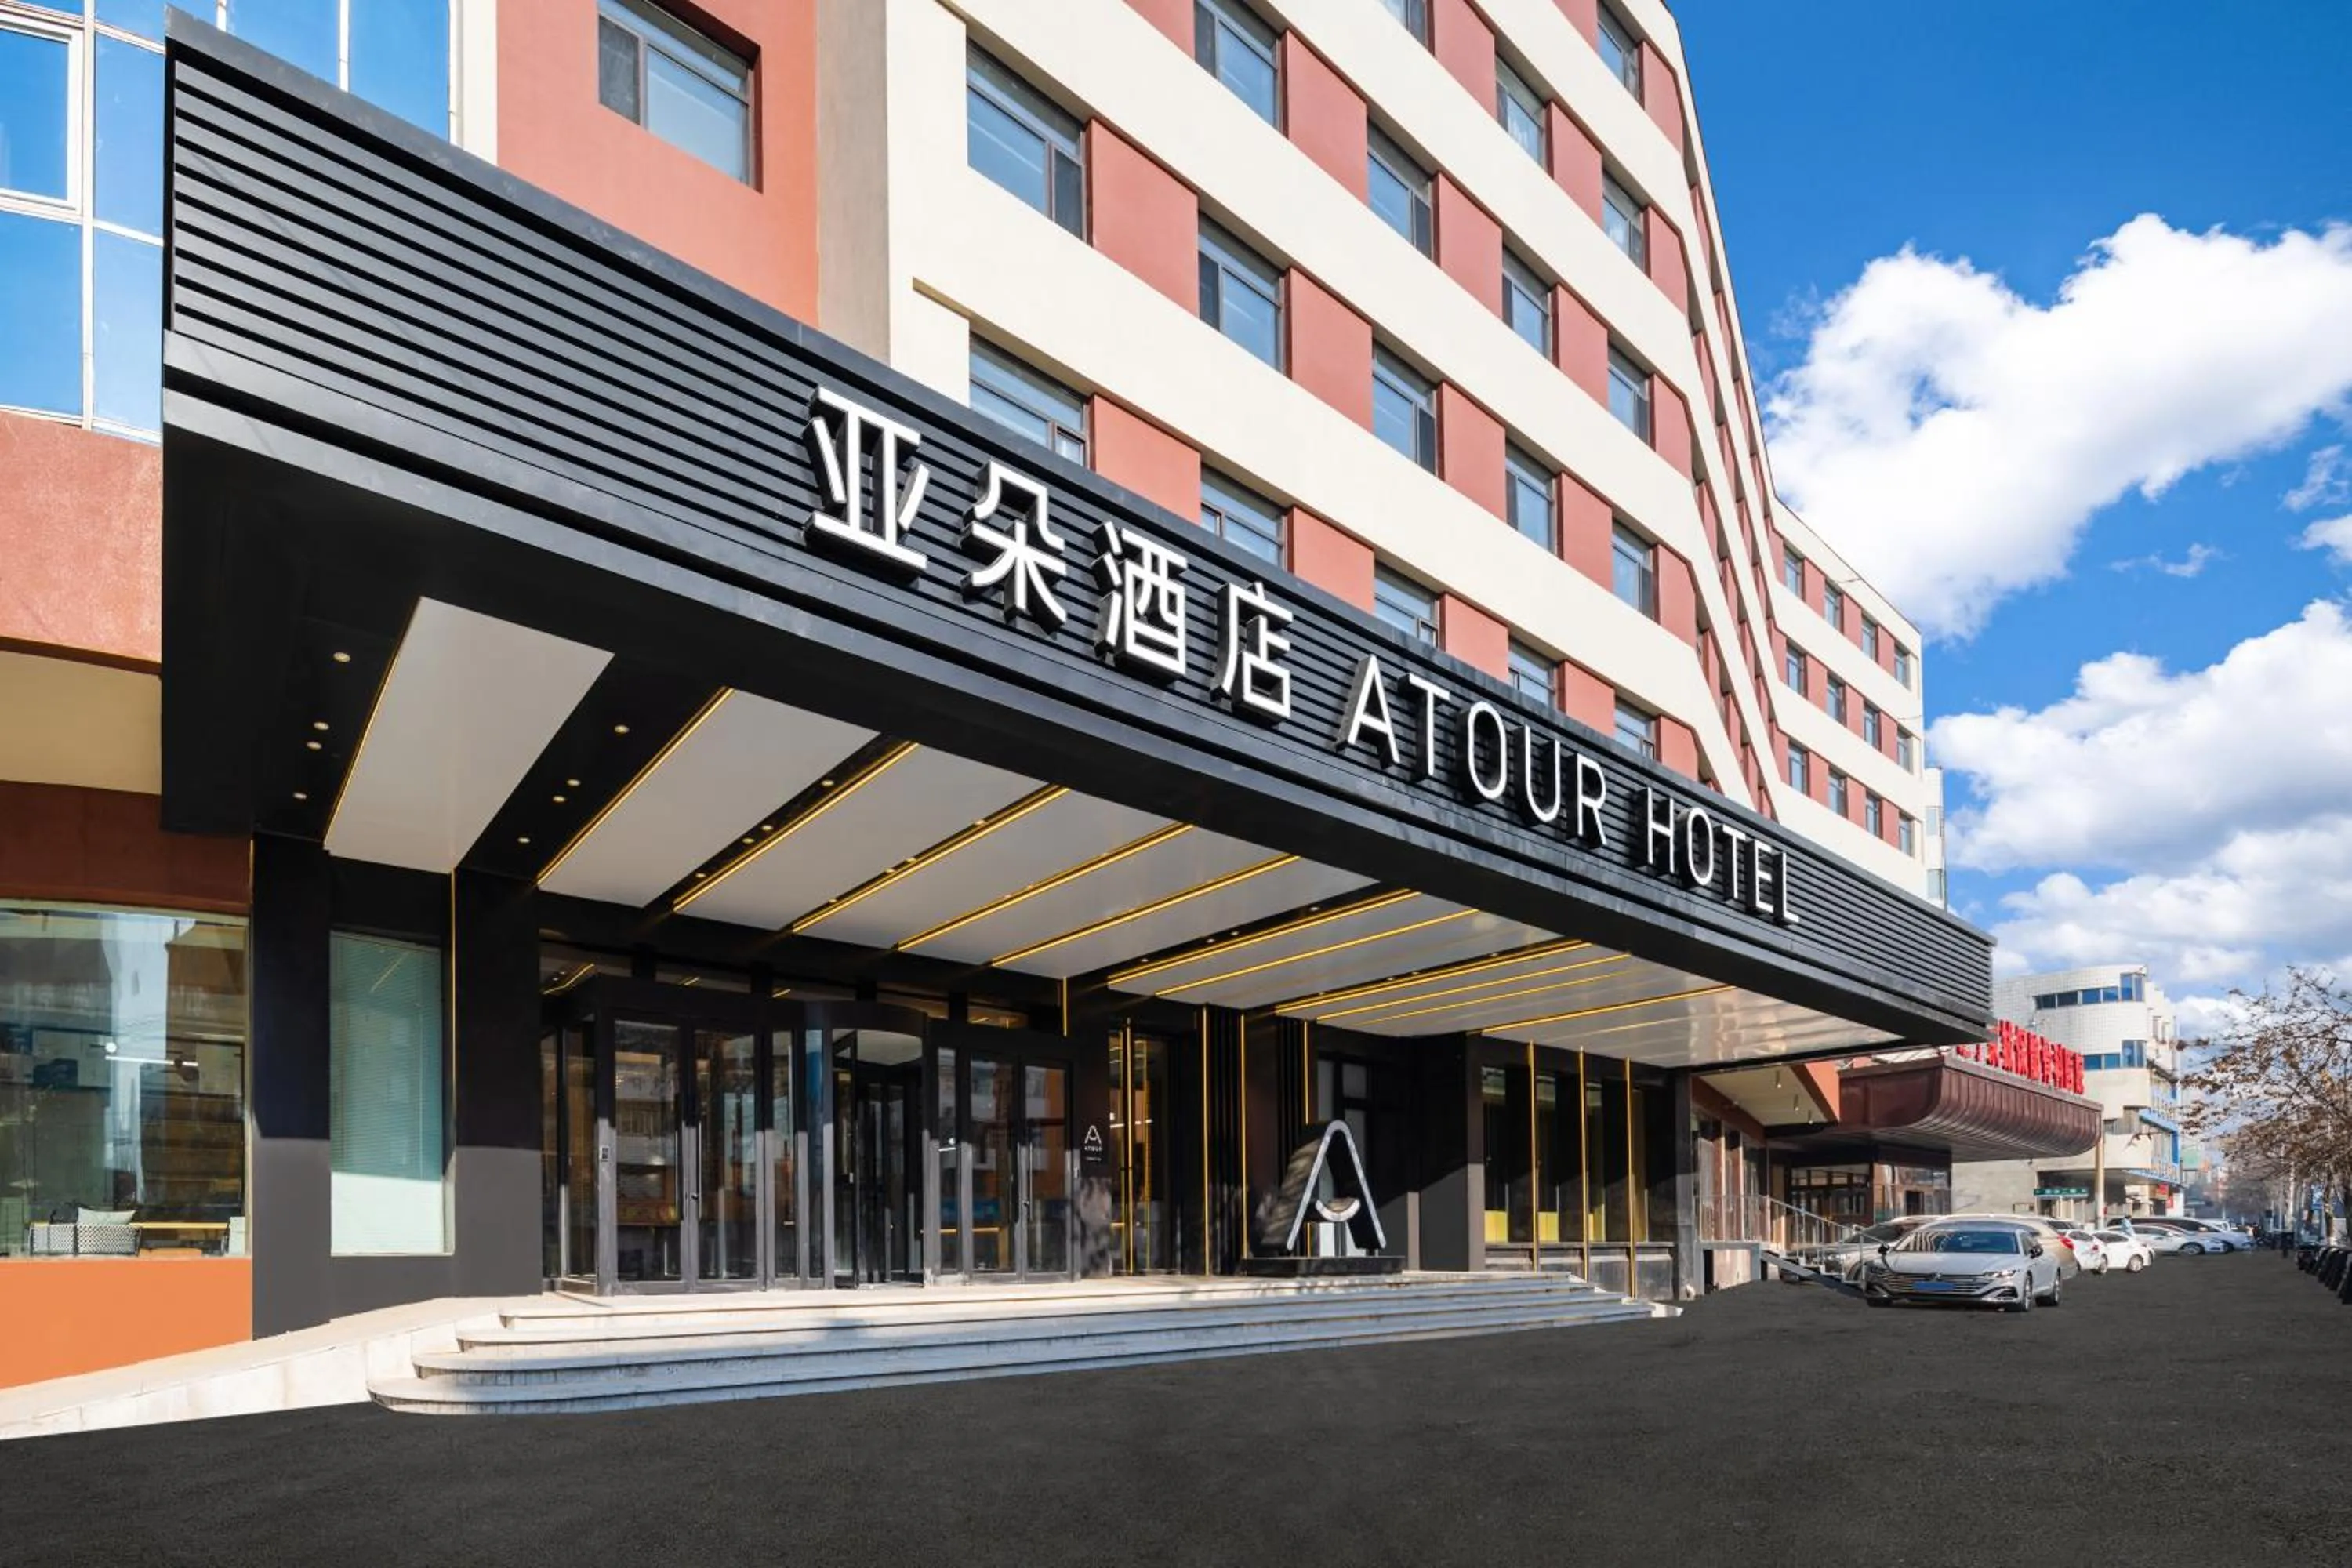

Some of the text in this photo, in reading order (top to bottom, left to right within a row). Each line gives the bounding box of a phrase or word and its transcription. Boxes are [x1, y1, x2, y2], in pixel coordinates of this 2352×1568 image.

[810, 386, 1294, 720] 亚朵酒店
[1345, 654, 1800, 924] ATOUR HOTEL
